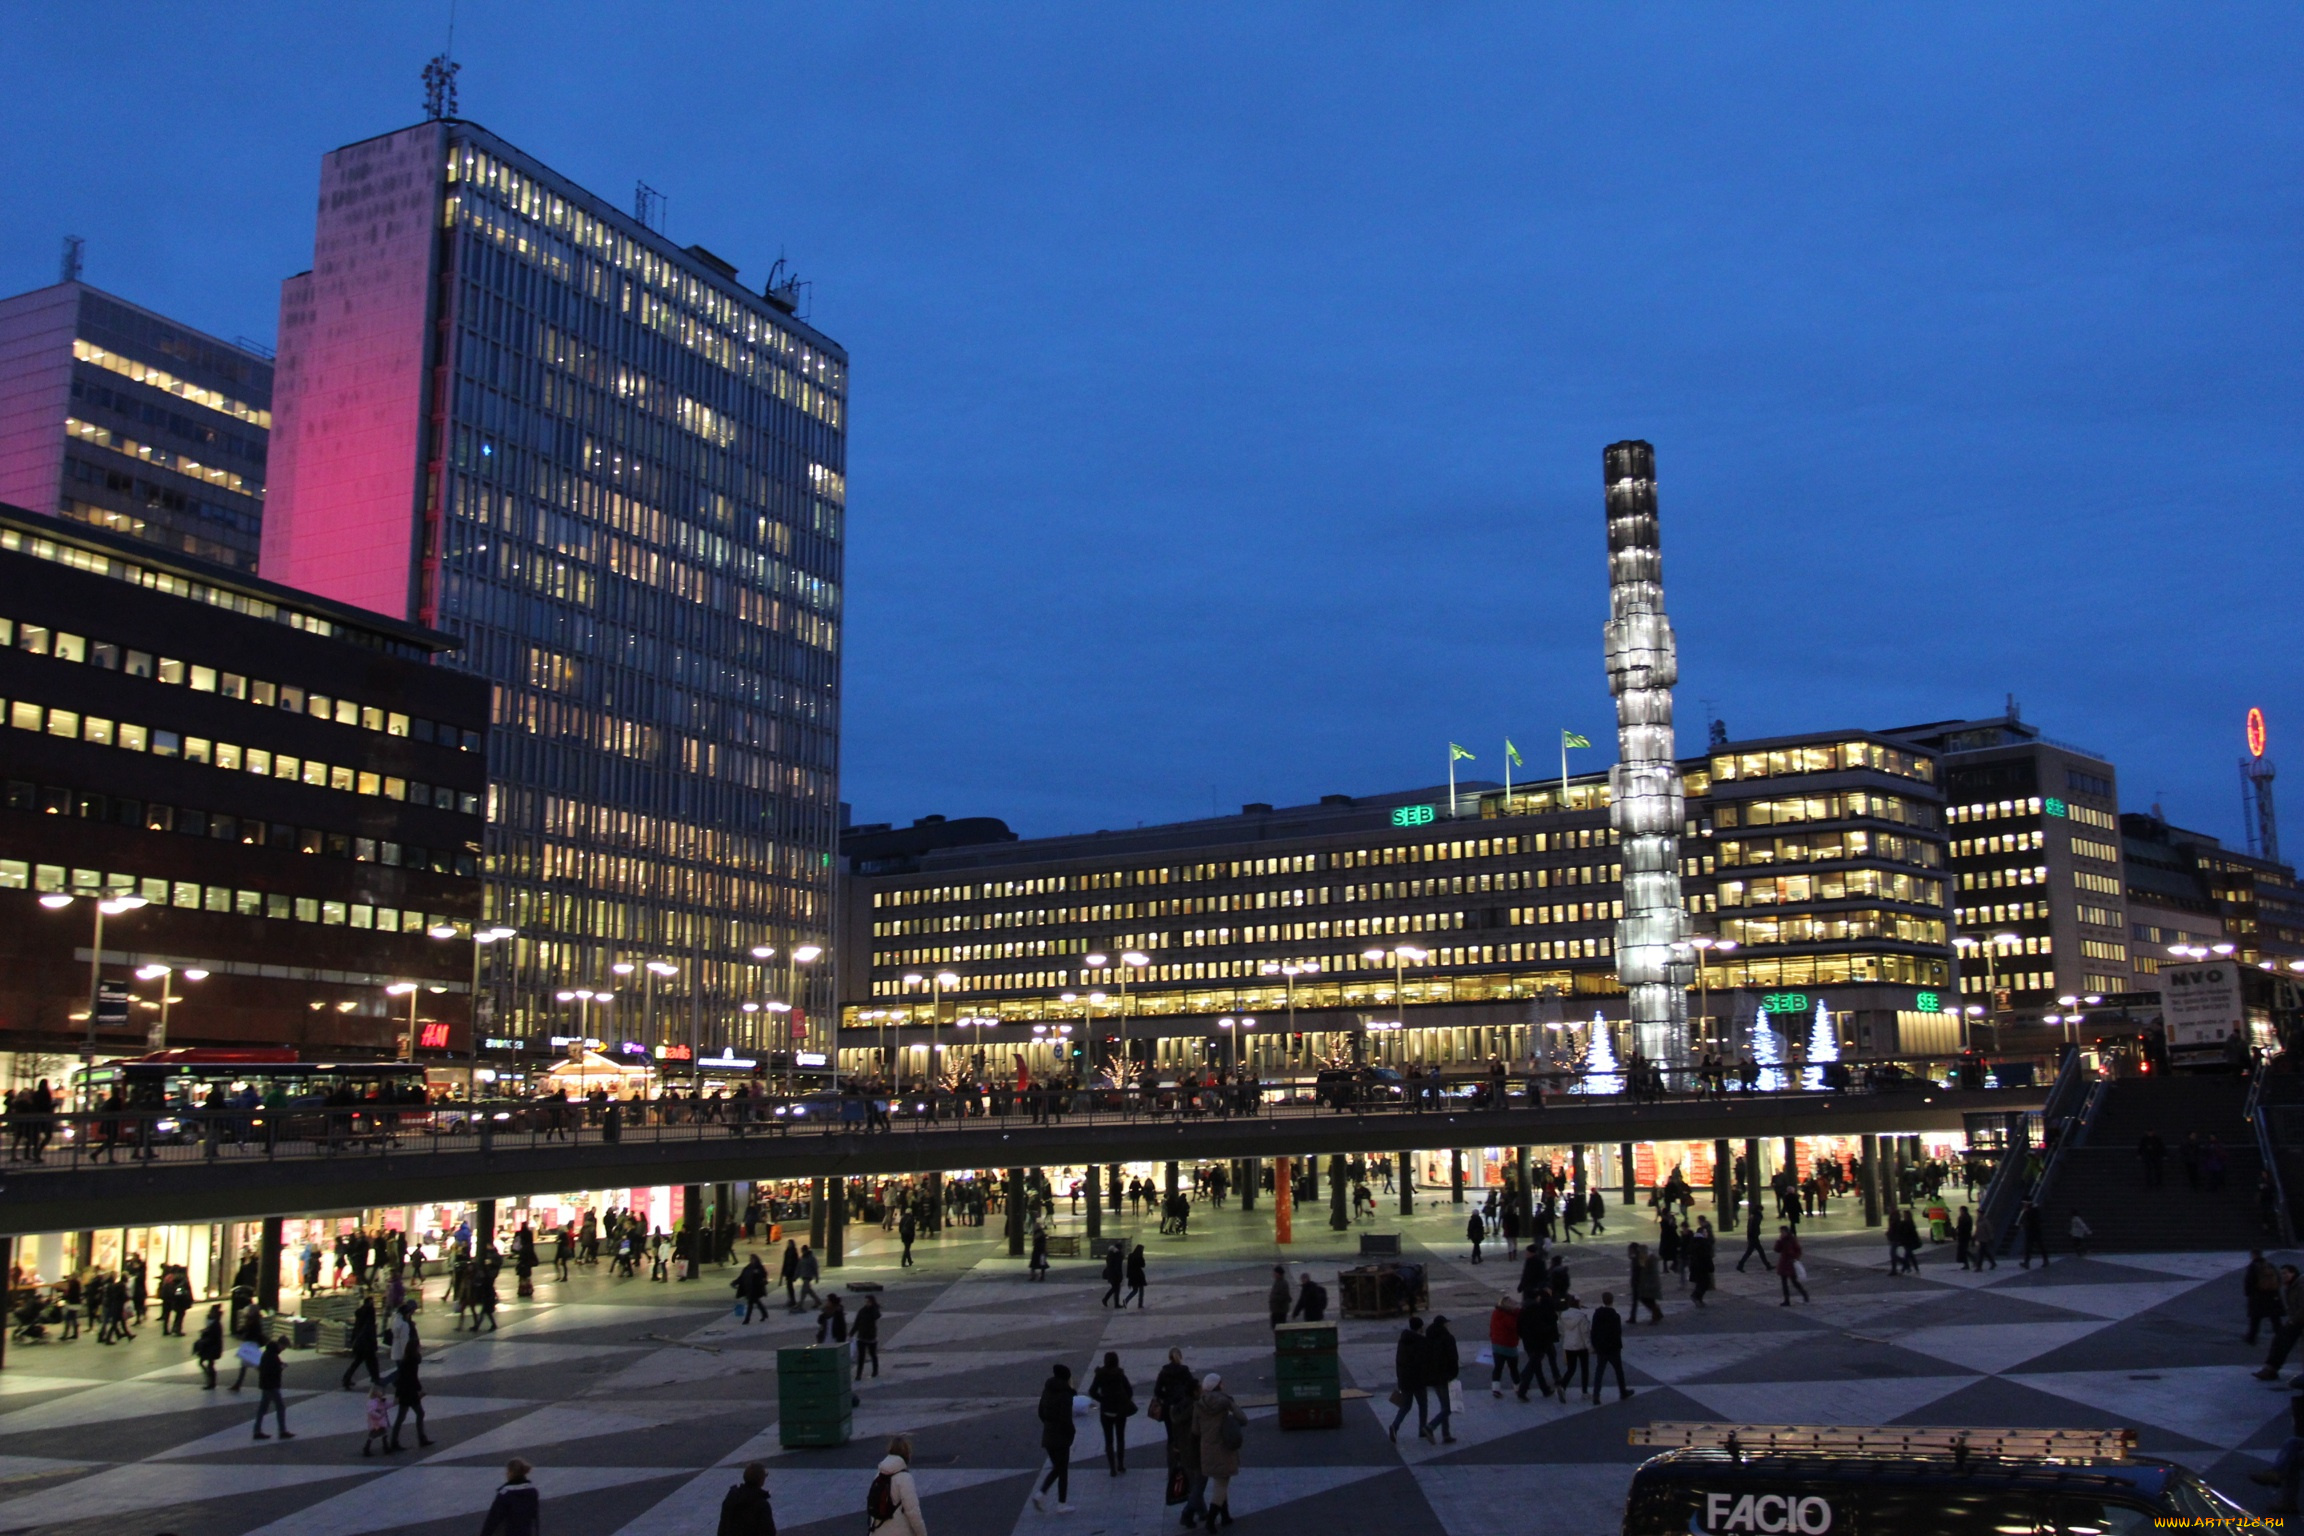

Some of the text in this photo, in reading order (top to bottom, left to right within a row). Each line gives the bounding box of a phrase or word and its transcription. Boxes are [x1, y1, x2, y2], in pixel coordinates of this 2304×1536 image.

[1393, 805, 1434, 827] SEB
[1762, 993, 1808, 1014] SEB
[421, 1024, 450, 1048] H&M
[1707, 1493, 1832, 1536] FACIO
